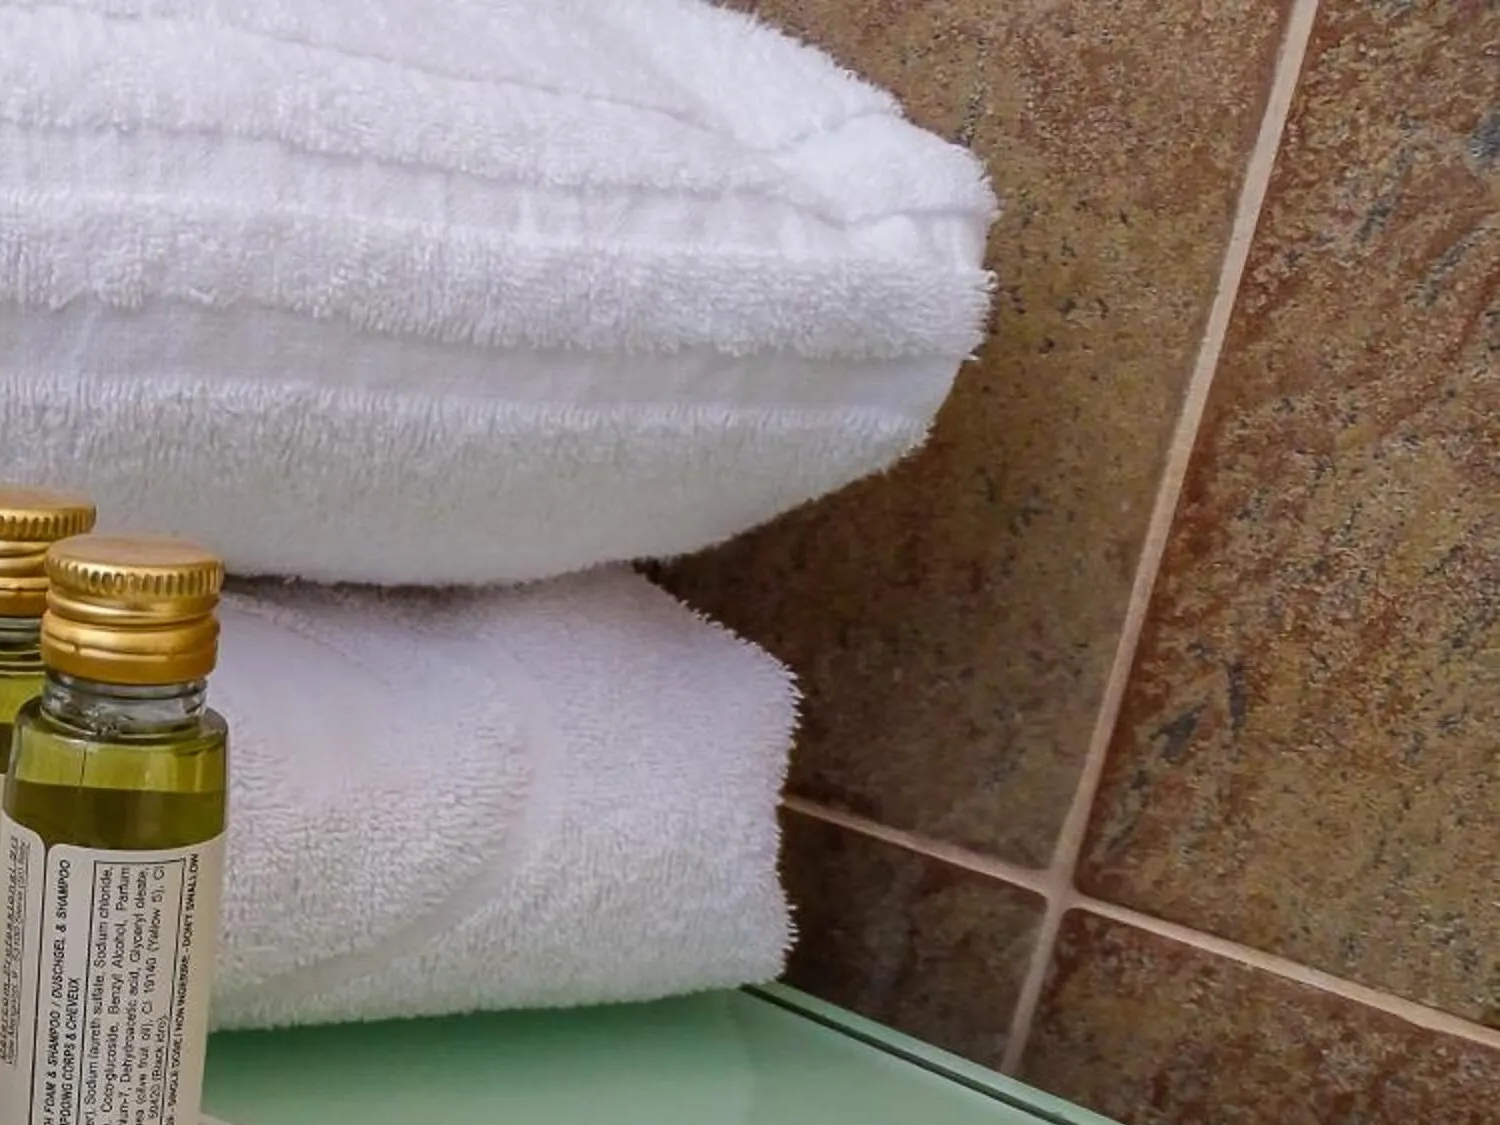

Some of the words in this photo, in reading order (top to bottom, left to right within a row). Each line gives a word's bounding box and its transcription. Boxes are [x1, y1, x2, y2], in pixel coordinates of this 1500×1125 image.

[56, 859, 71, 919] SHAMPOO
[65, 978, 80, 1030] CHEVEUX
[46, 1011, 61, 1066] SHAMPOO
[62, 1044, 74, 1081] CORPS
[44, 1082, 56, 1113] FOAM
